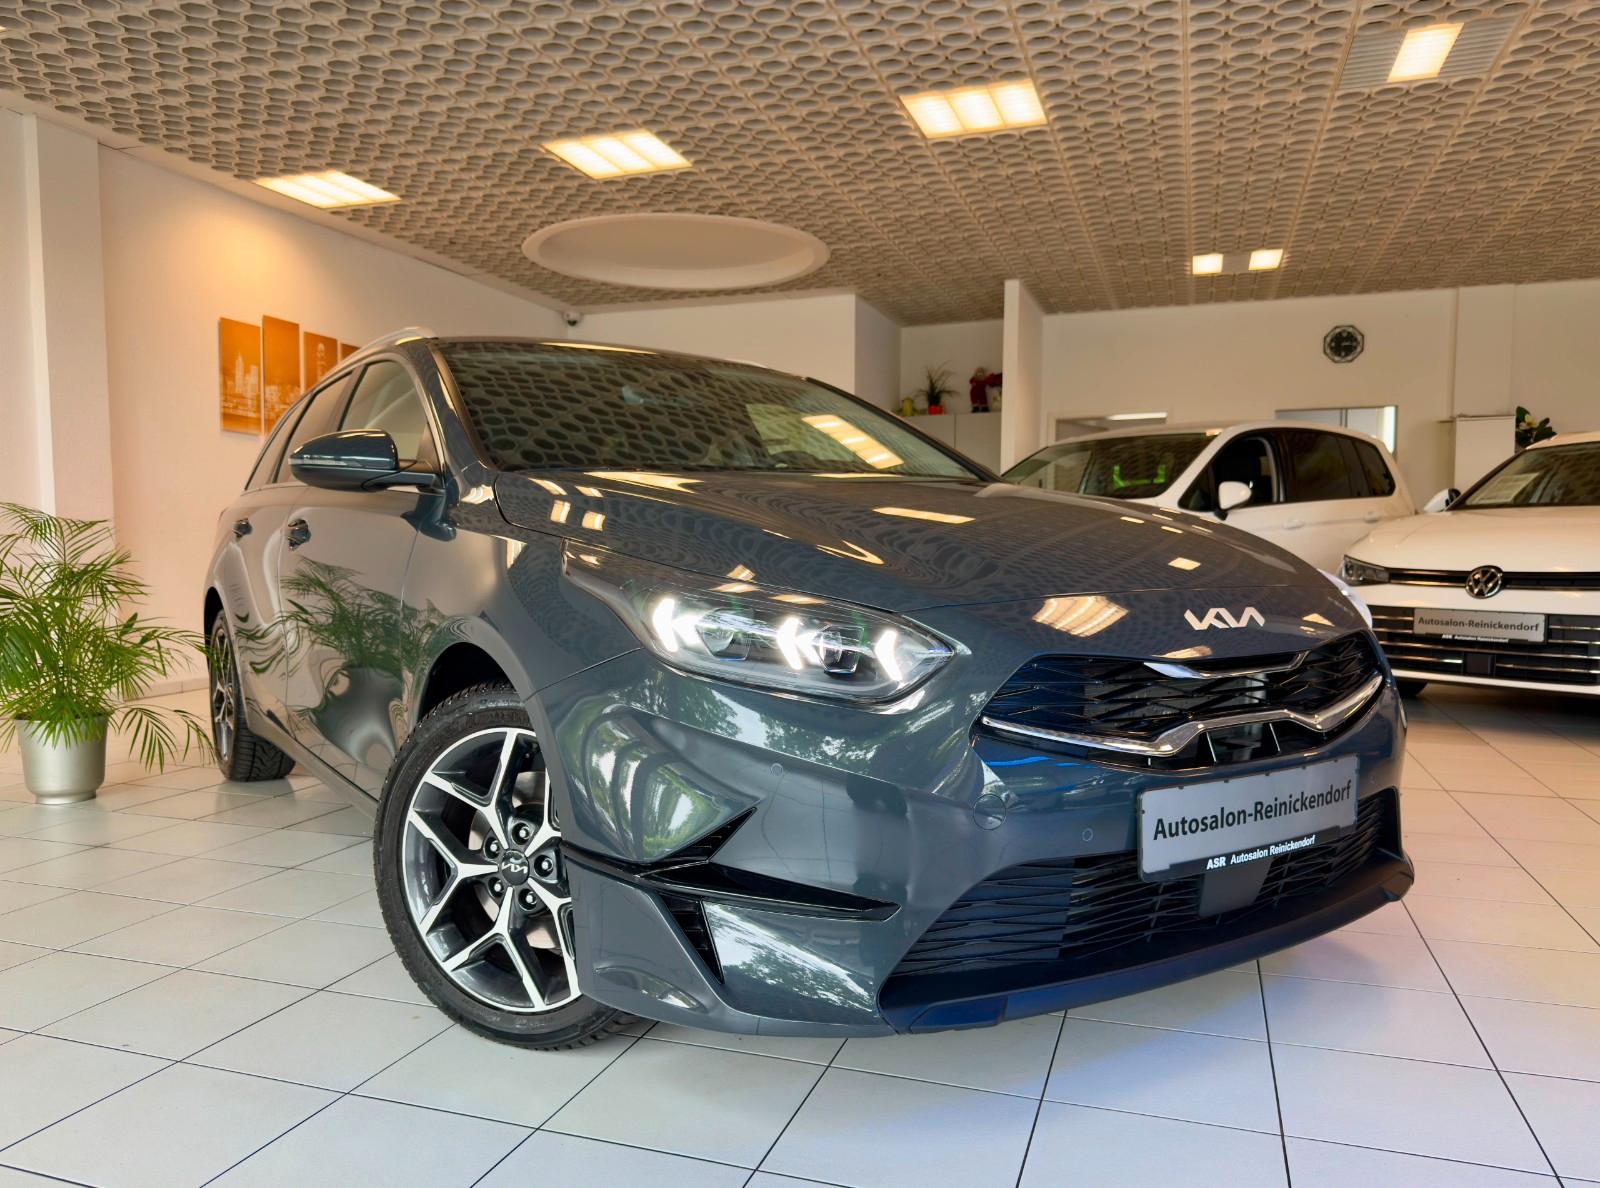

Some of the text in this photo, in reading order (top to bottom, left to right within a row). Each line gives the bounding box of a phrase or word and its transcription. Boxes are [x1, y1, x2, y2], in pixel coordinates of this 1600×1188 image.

[1183, 606, 1266, 631] KIA
[1417, 617, 1541, 632] Autosalon-Reinickendorf
[1153, 779, 1352, 841] Autosalon-Reinickendorf
[1206, 835, 1316, 870] ASR Autosalon Reinickendorf
